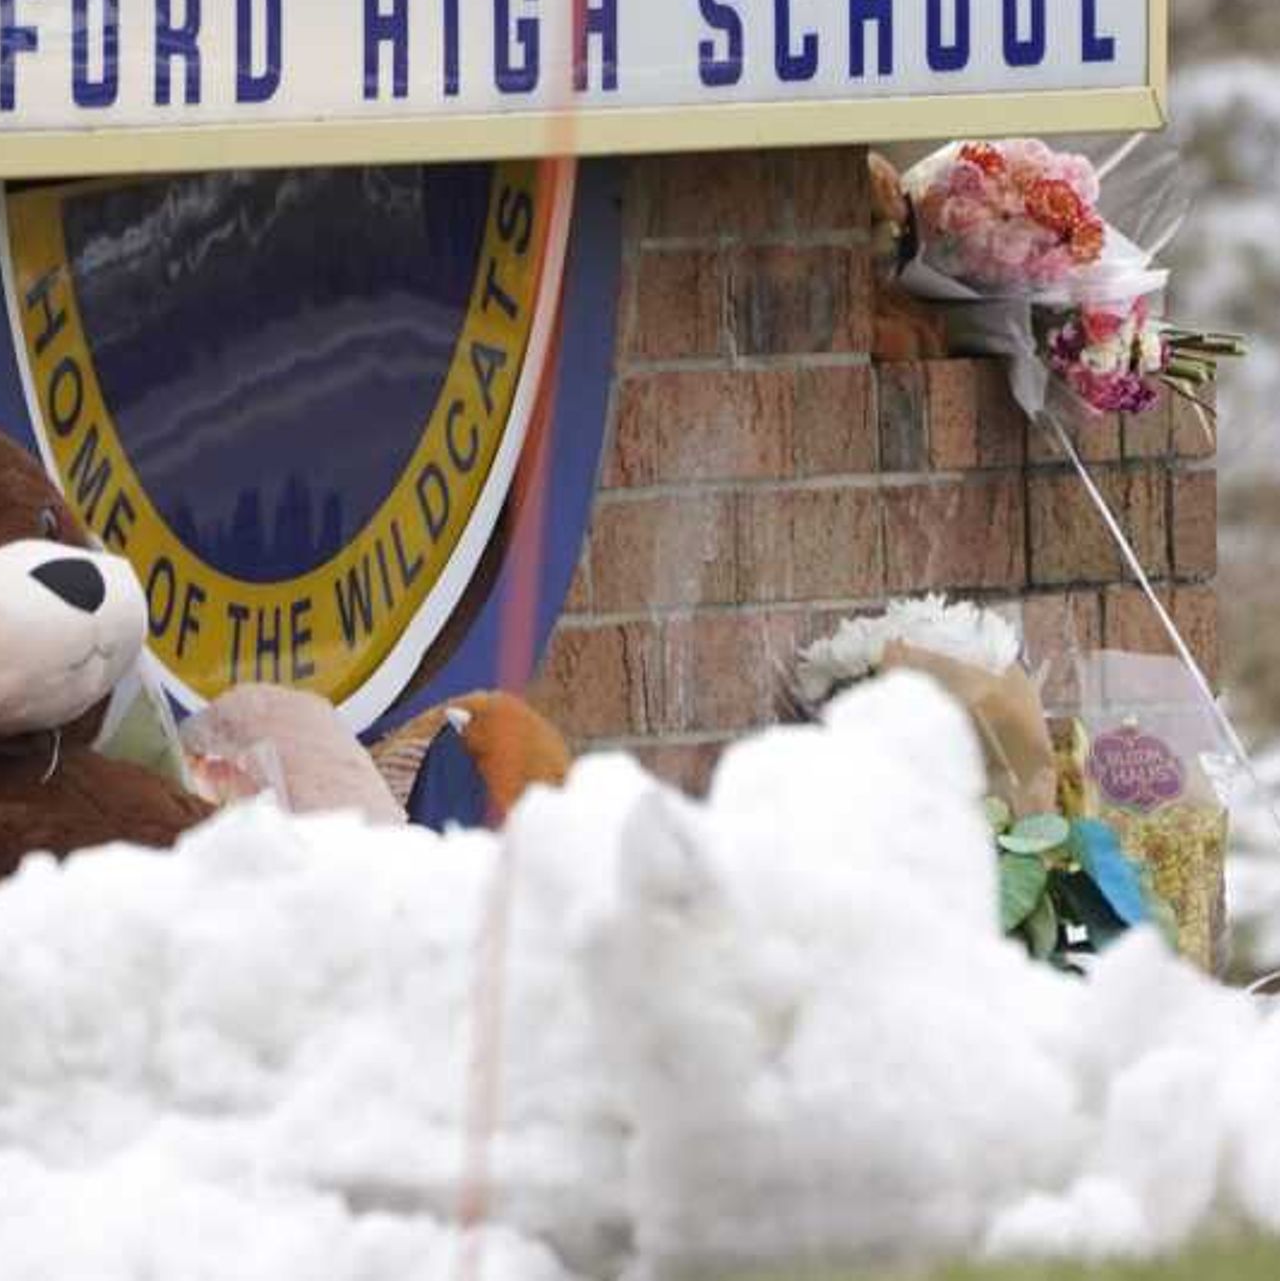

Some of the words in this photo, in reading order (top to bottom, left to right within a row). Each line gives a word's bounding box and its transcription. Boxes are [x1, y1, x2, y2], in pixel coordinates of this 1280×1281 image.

[25, 266, 136, 551] HOME
[146, 557, 207, 660] OF
[227, 597, 316, 685] THE
[334, 185, 534, 649] WILDCATS
